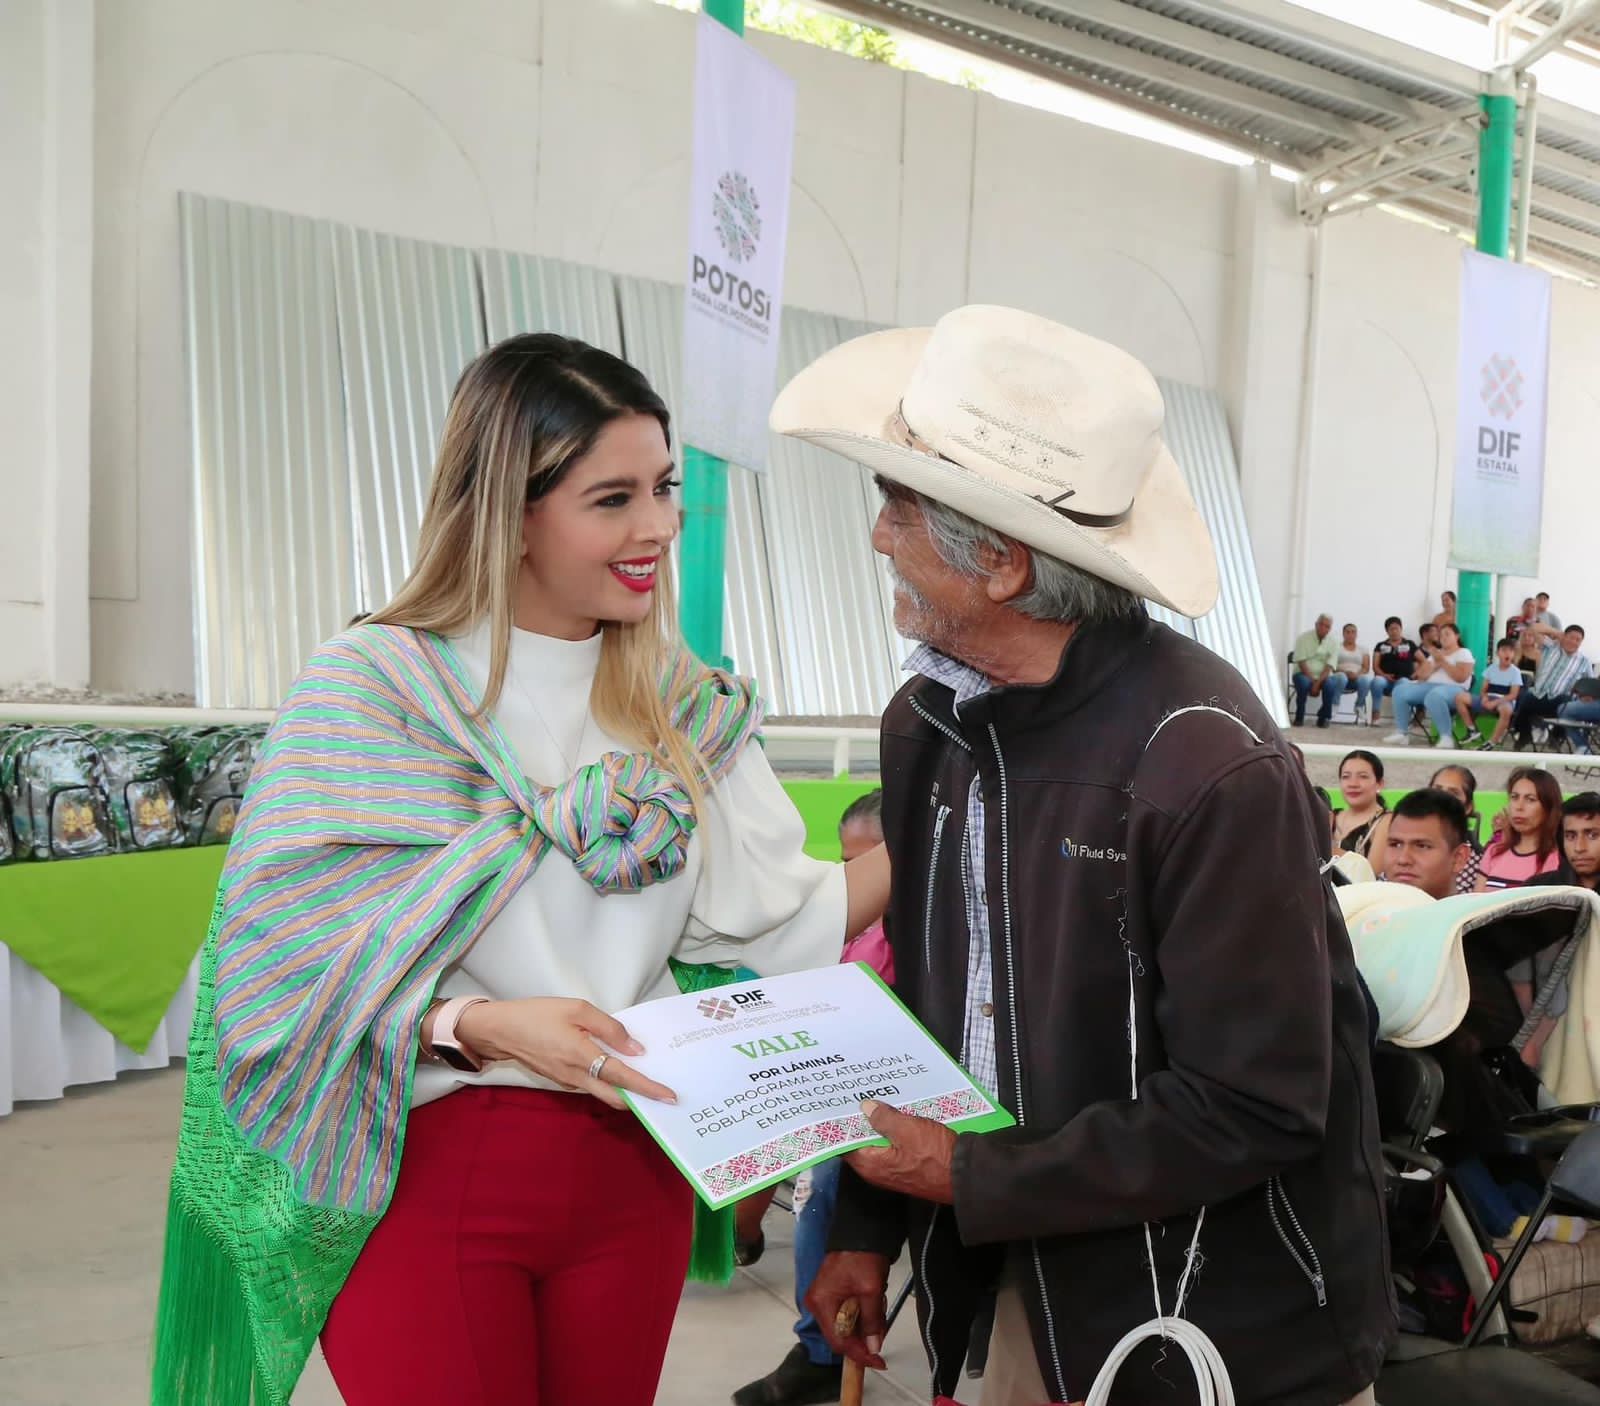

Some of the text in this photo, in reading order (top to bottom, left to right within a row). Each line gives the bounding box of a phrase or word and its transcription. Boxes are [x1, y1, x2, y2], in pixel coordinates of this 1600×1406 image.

[1478, 426, 1520, 458] DIF
[1477, 457, 1519, 474] ESTATAL
[1079, 845, 1104, 859] Fluid
[730, 989, 766, 1005] DIF
[740, 1000, 773, 1009] ESTATAL
[731, 1030, 819, 1059] VALE
[749, 1054, 845, 1082] POR LÁMINAS
[689, 1053, 914, 1124] DEL PROGRAMA DE ATENCIÓN A
[696, 1064, 929, 1137] POBLACIÓN EN CONDICIONES DE
[756, 1085, 900, 1129] EMERGENCIA (APCE)
